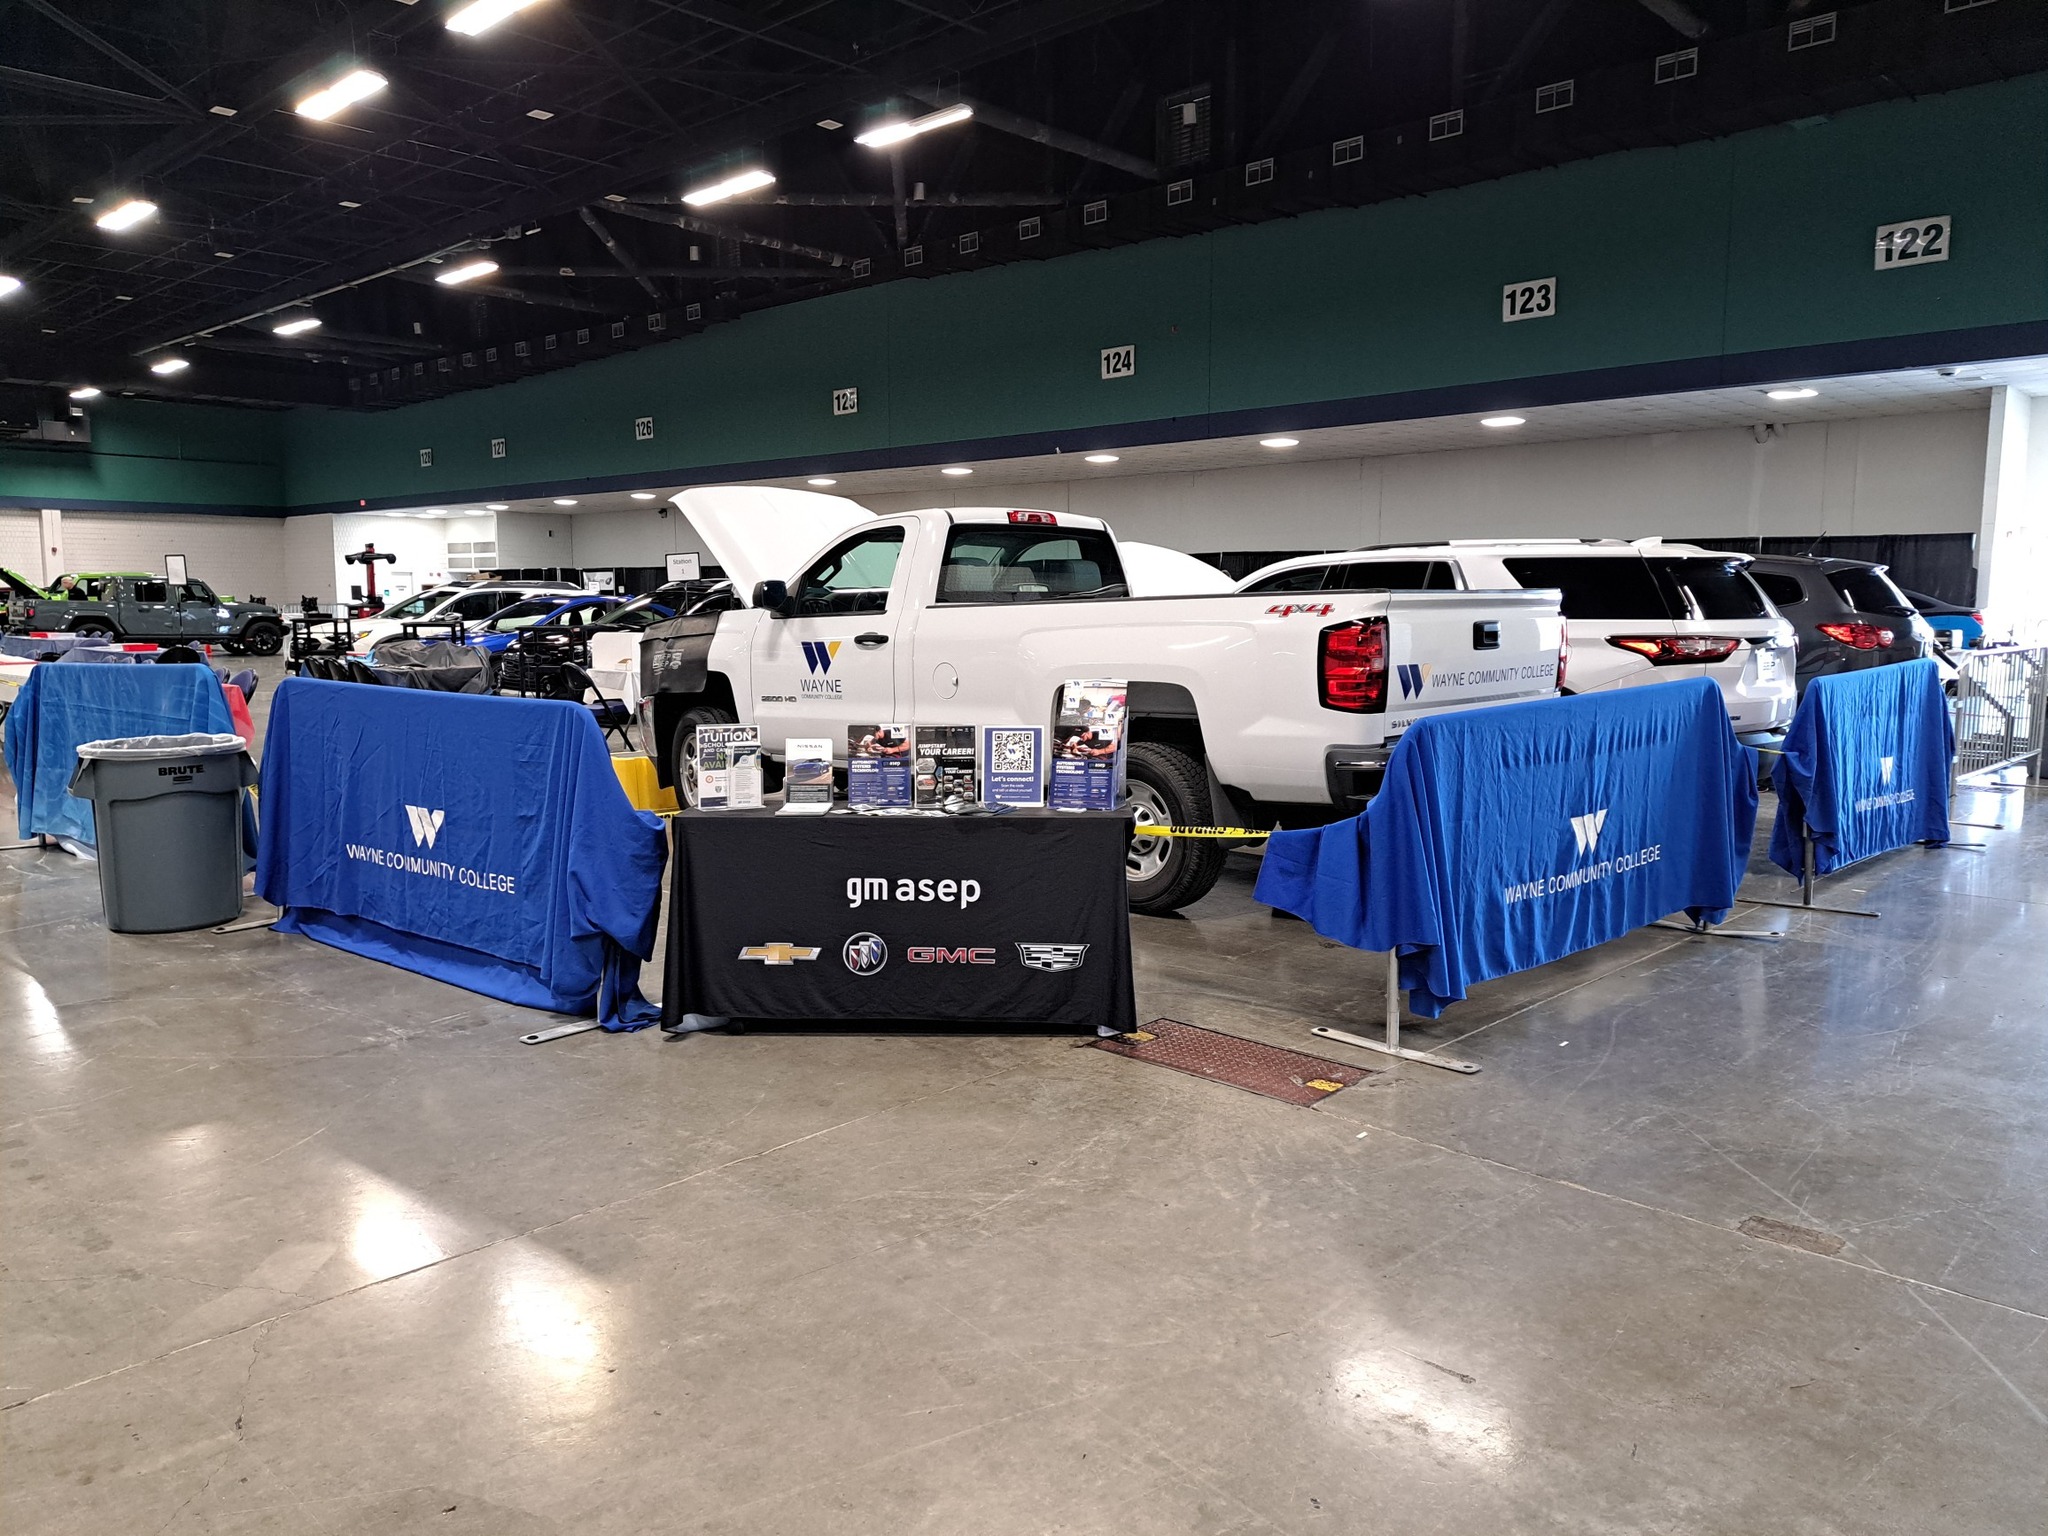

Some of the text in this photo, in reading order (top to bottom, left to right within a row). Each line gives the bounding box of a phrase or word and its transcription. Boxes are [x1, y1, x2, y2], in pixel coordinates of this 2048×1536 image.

[1880, 224, 1943, 262] 122
[1505, 284, 1551, 316] 123
[1103, 350, 1132, 374] 124
[835, 392, 855, 411] 125
[636, 420, 652, 436] 126
[493, 441, 504, 455] 127
[1432, 663, 1554, 688] WAYNE COMMUNITY COLLEGE
[800, 679, 842, 693] WAYNE
[703, 731, 752, 742] TUITION
[920, 747, 975, 756] YOUR CAREER!
[158, 764, 205, 776] BRUTE
[346, 844, 516, 894] WAYNE COMMUNITY COLLEGE
[1505, 844, 1661, 904] WAYNE COMMUNITY COLLEGE
[846, 878, 981, 910] gm asep
[907, 946, 996, 964] GMC
